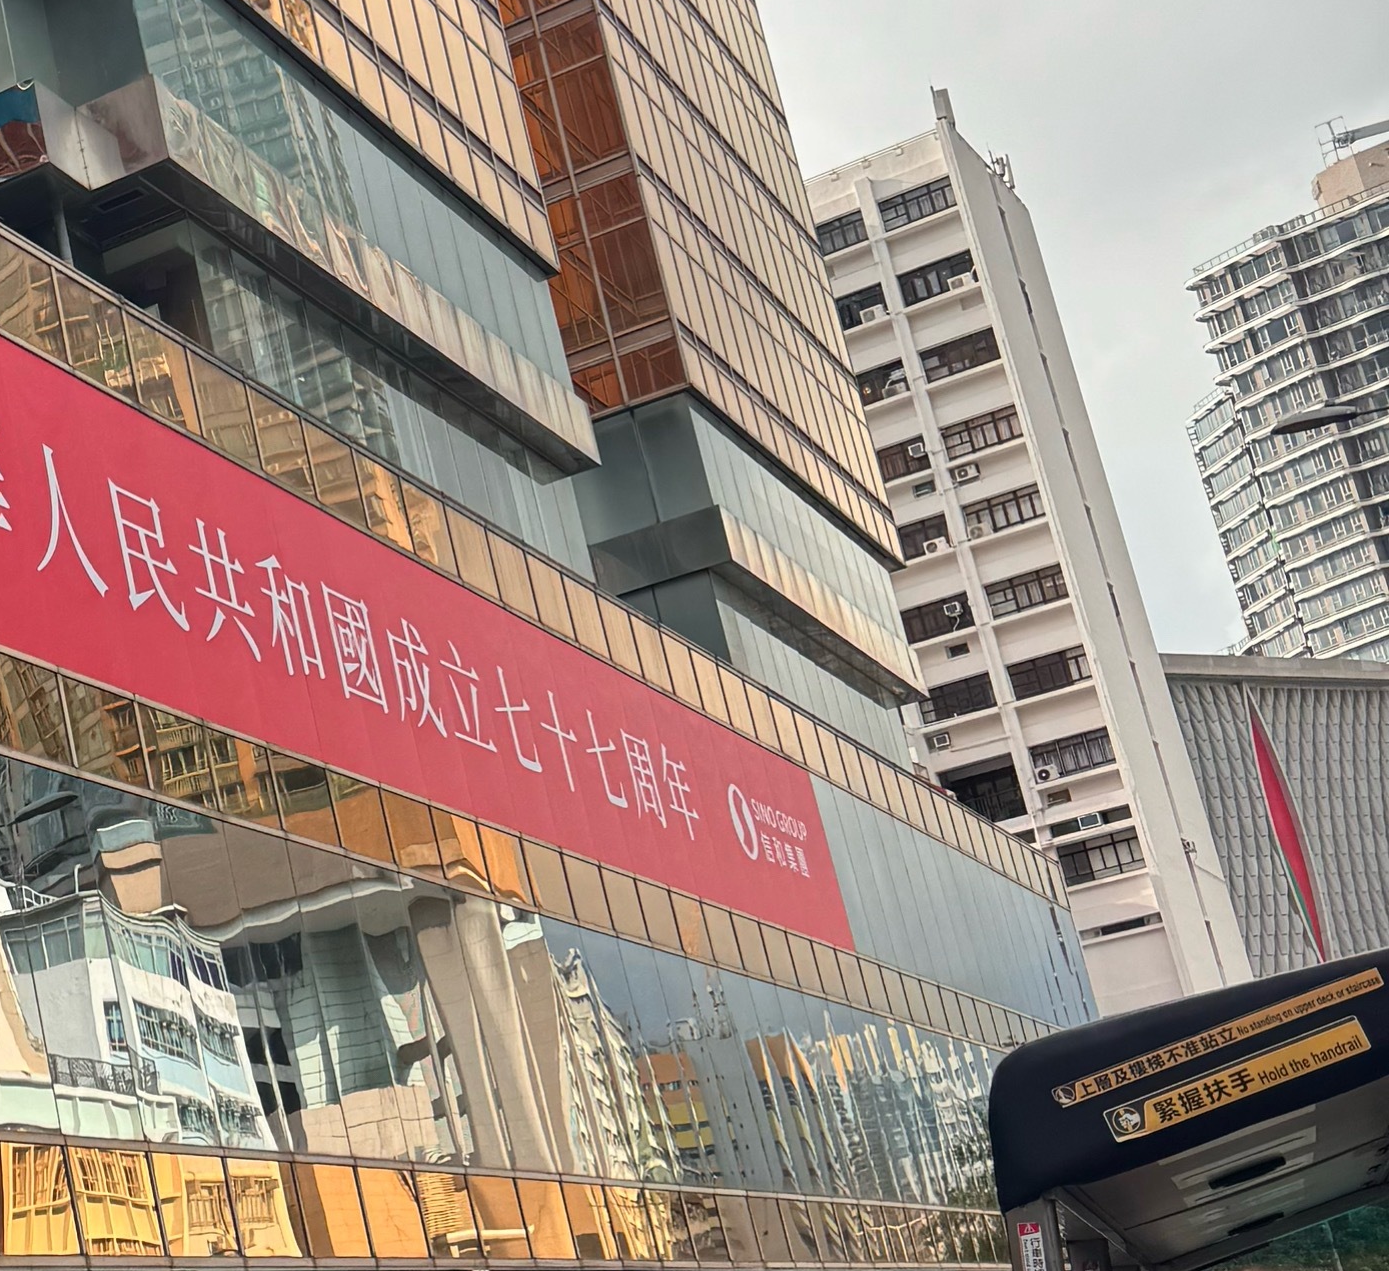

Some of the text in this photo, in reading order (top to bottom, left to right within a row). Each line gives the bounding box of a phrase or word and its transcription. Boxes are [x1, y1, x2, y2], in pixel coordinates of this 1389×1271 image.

[751, 798, 807, 841] SINO GROUP
[760, 830, 810, 878] 信和集團
[1079, 1026, 1238, 1099] 上層及樓梯不准站立
[1236, 1025, 1250, 1036] No
[1249, 1013, 1284, 1031] standing
[1282, 1008, 1294, 1018] on
[1293, 1000, 1317, 1015] upper
[1336, 988, 1345, 999] or
[1344, 976, 1382, 995] staircase
[1153, 1034, 1364, 1124] 緊握扶手 Hold the handrail
